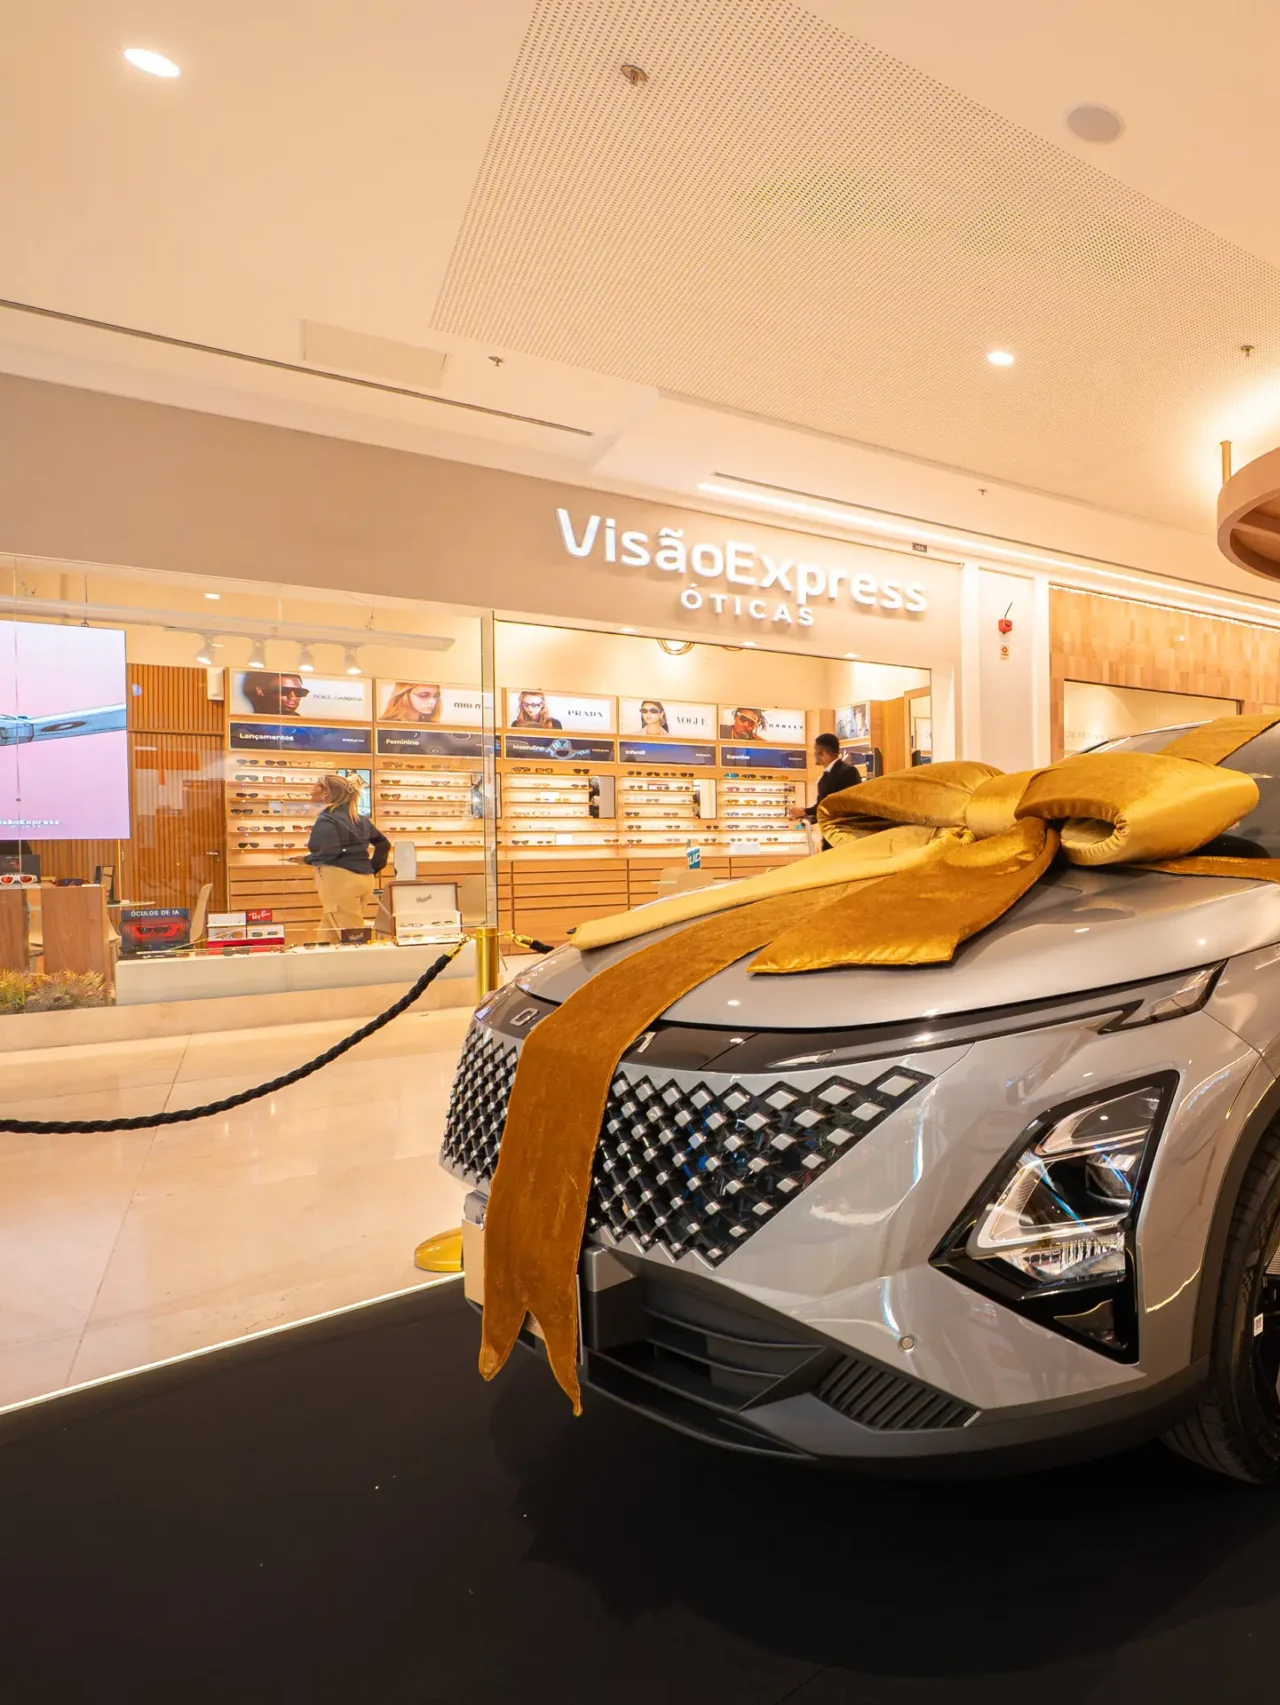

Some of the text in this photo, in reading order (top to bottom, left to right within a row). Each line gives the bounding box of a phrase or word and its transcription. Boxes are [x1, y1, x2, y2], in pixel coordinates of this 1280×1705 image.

[556, 507, 929, 613] VisãoExpress
[680, 582, 814, 627] ÓTICAS
[567, 709, 603, 719] PRADA
[676, 715, 708, 726] VOGUE
[239, 731, 295, 743] Lançamentos
[385, 738, 420, 746] Feminino
[512, 743, 545, 751] Masculino
[625, 748, 646, 756] Infantil
[130, 909, 159, 918] ÓCULOS
